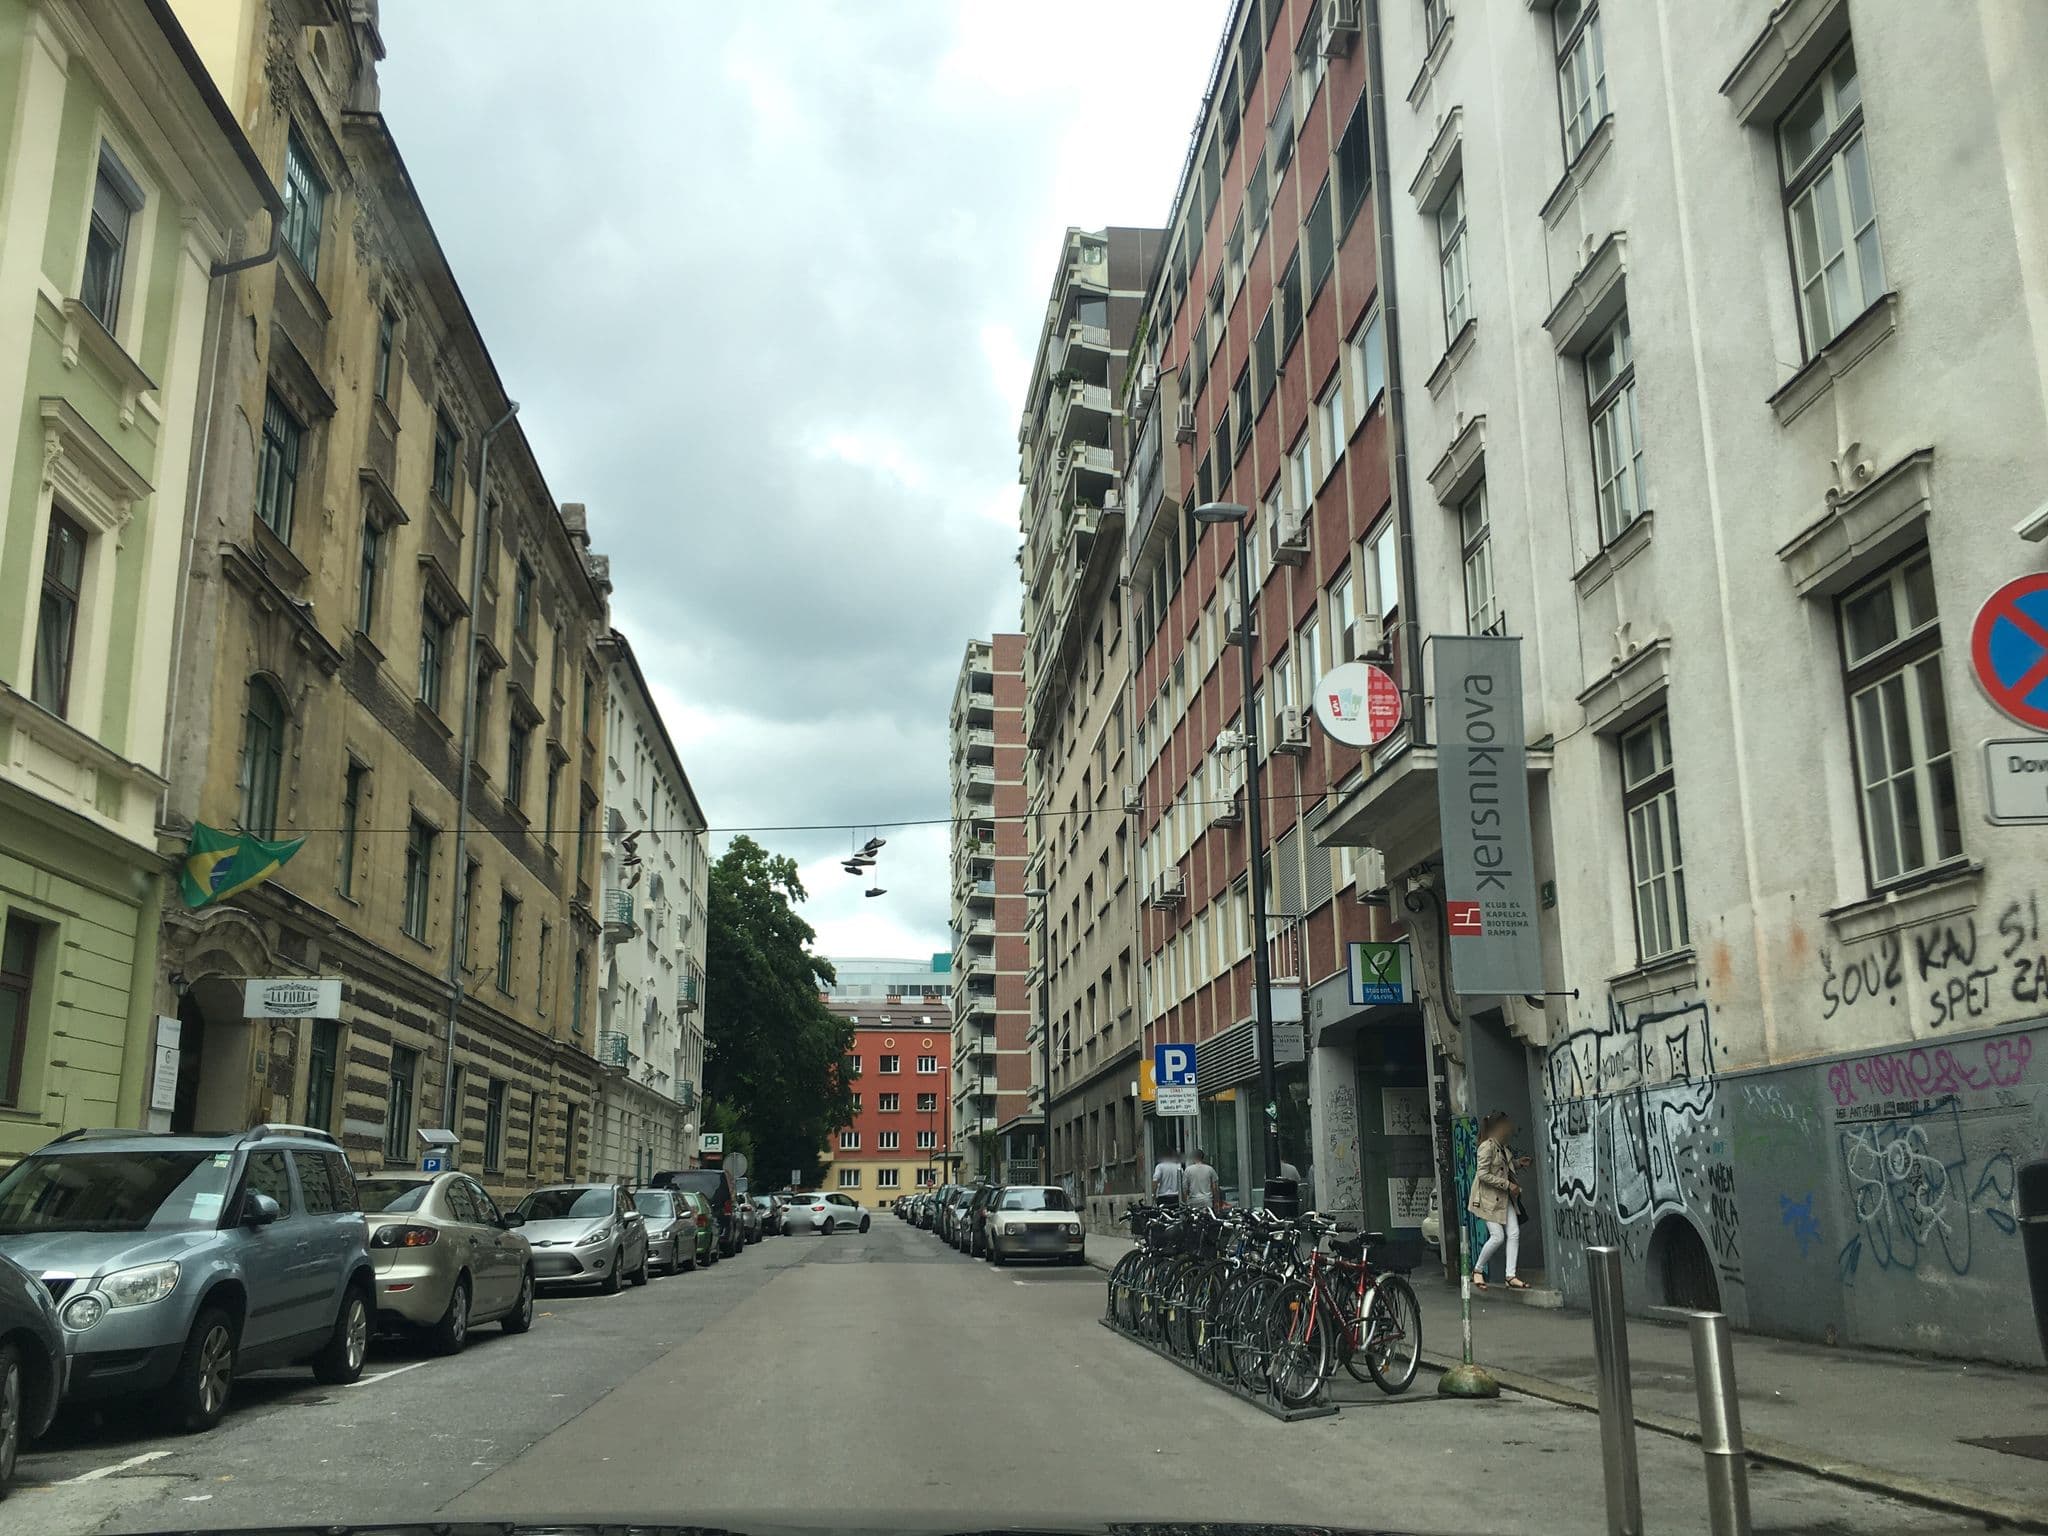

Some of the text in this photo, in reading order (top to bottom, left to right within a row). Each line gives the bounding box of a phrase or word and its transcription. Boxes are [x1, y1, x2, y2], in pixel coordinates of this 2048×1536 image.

[2008, 755, 2048, 774] Dov
[1488, 929, 1518, 937] RAMPA
[1930, 965, 1998, 1028] SPET
[1165, 1049, 1187, 1081] P
[705, 1135, 719, 1147] pa
[428, 1160, 436, 1168] P
